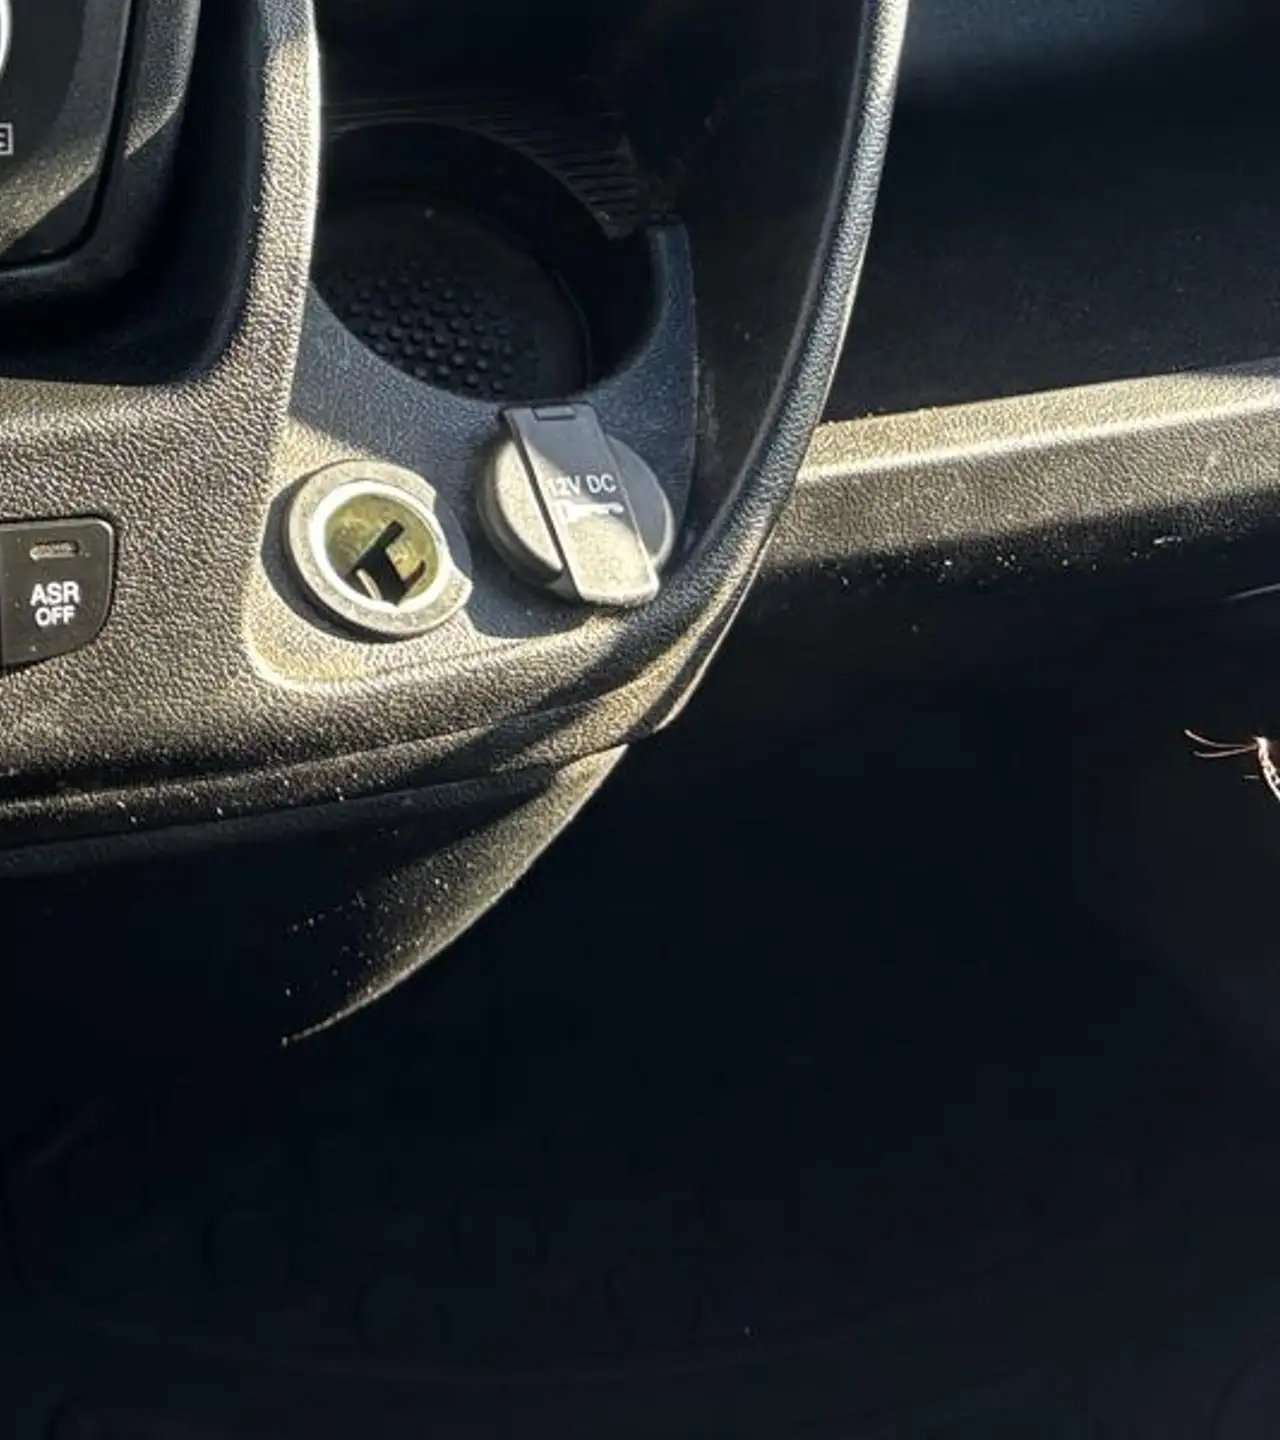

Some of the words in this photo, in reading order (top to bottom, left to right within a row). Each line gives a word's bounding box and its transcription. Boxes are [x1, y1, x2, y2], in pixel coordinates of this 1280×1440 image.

[545, 474, 581, 497] 12V
[585, 471, 617, 494] DC
[29, 580, 81, 607] ASR
[34, 604, 76, 628] OFF
